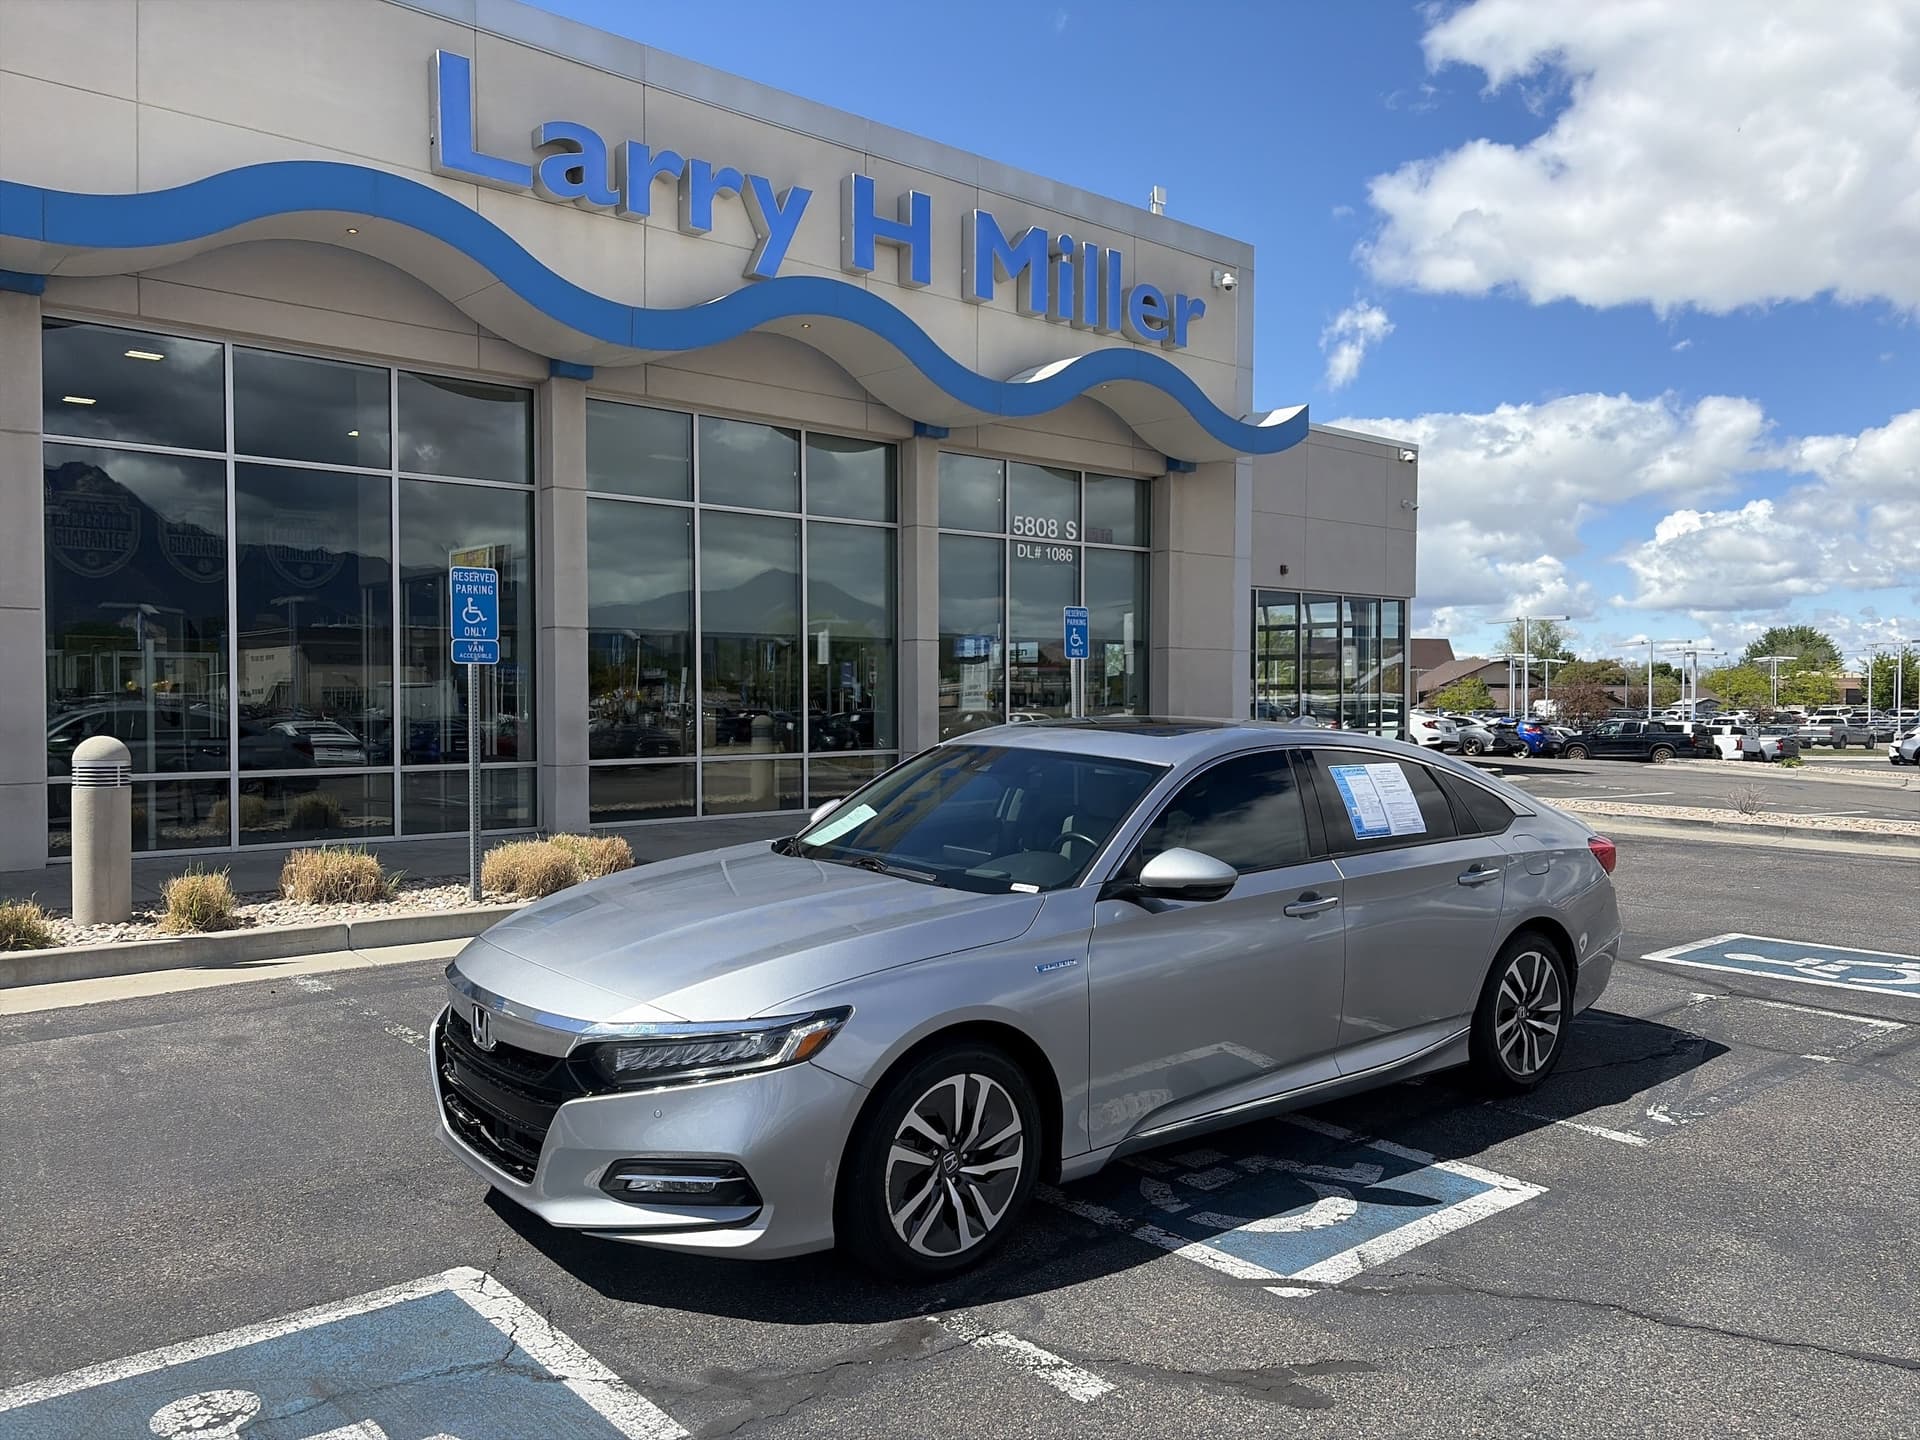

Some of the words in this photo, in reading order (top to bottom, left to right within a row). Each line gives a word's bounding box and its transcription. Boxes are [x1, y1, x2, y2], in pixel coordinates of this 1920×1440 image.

[431, 49, 812, 279] Larry
[842, 172, 931, 288] H
[963, 209, 1205, 351] Miller
[1013, 515, 1058, 538] 5808
[1065, 520, 1077, 540] S
[1017, 543, 1041, 559] DL#
[1045, 547, 1073, 562] 1086
[452, 571, 496, 583] RESERVED
[455, 584, 494, 595] PARKING
[1065, 609, 1088, 618] RESERVED
[1066, 618, 1087, 626] PARKING
[464, 626, 487, 637] ONLY
[467, 644, 484, 652] VAN
[1071, 648, 1083, 656] ONLY
